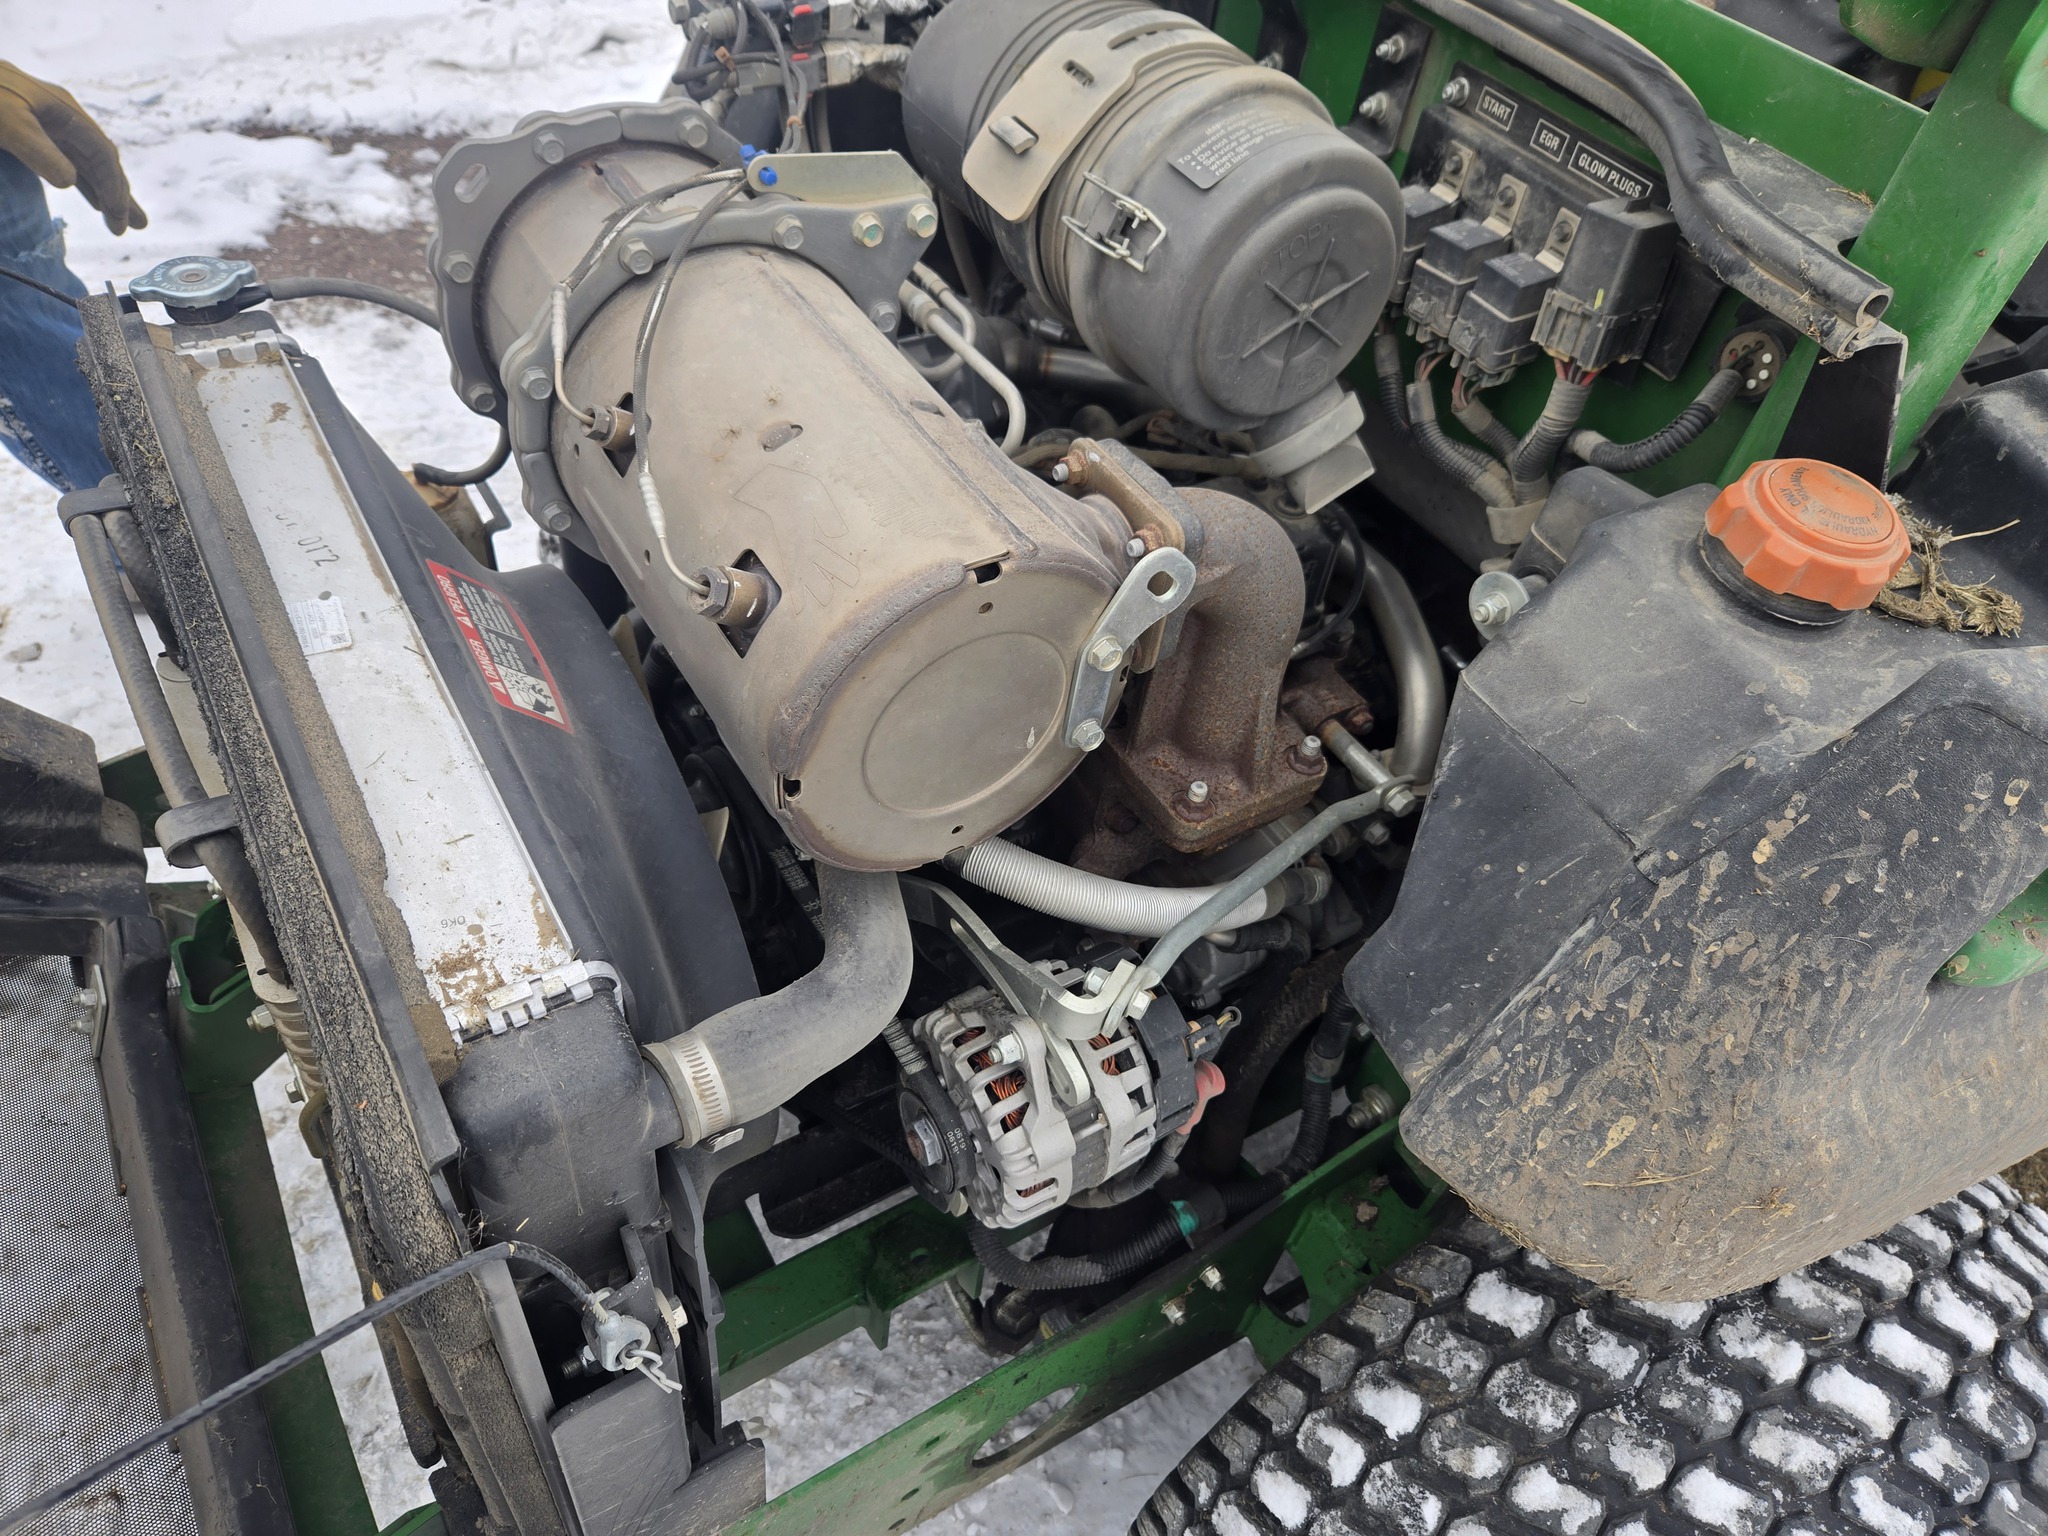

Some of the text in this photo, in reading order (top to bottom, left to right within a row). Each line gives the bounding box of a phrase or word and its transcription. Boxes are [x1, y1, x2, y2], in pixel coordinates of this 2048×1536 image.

[1482, 96, 1512, 122] START
[1177, 154, 1191, 164] To
[1192, 129, 1226, 156] prevent
[1197, 150, 1211, 162] Do
[1212, 138, 1228, 151] not
[1539, 129, 1561, 151] EGR
[1203, 141, 1238, 166] Service
[1215, 150, 1250, 176] red line
[1578, 153, 1642, 198] GLOW PLUGS
[1780, 487, 1801, 507] ONLY
[437, 574, 466, 616] PELIGRO
[469, 638, 499, 680] DANGER
